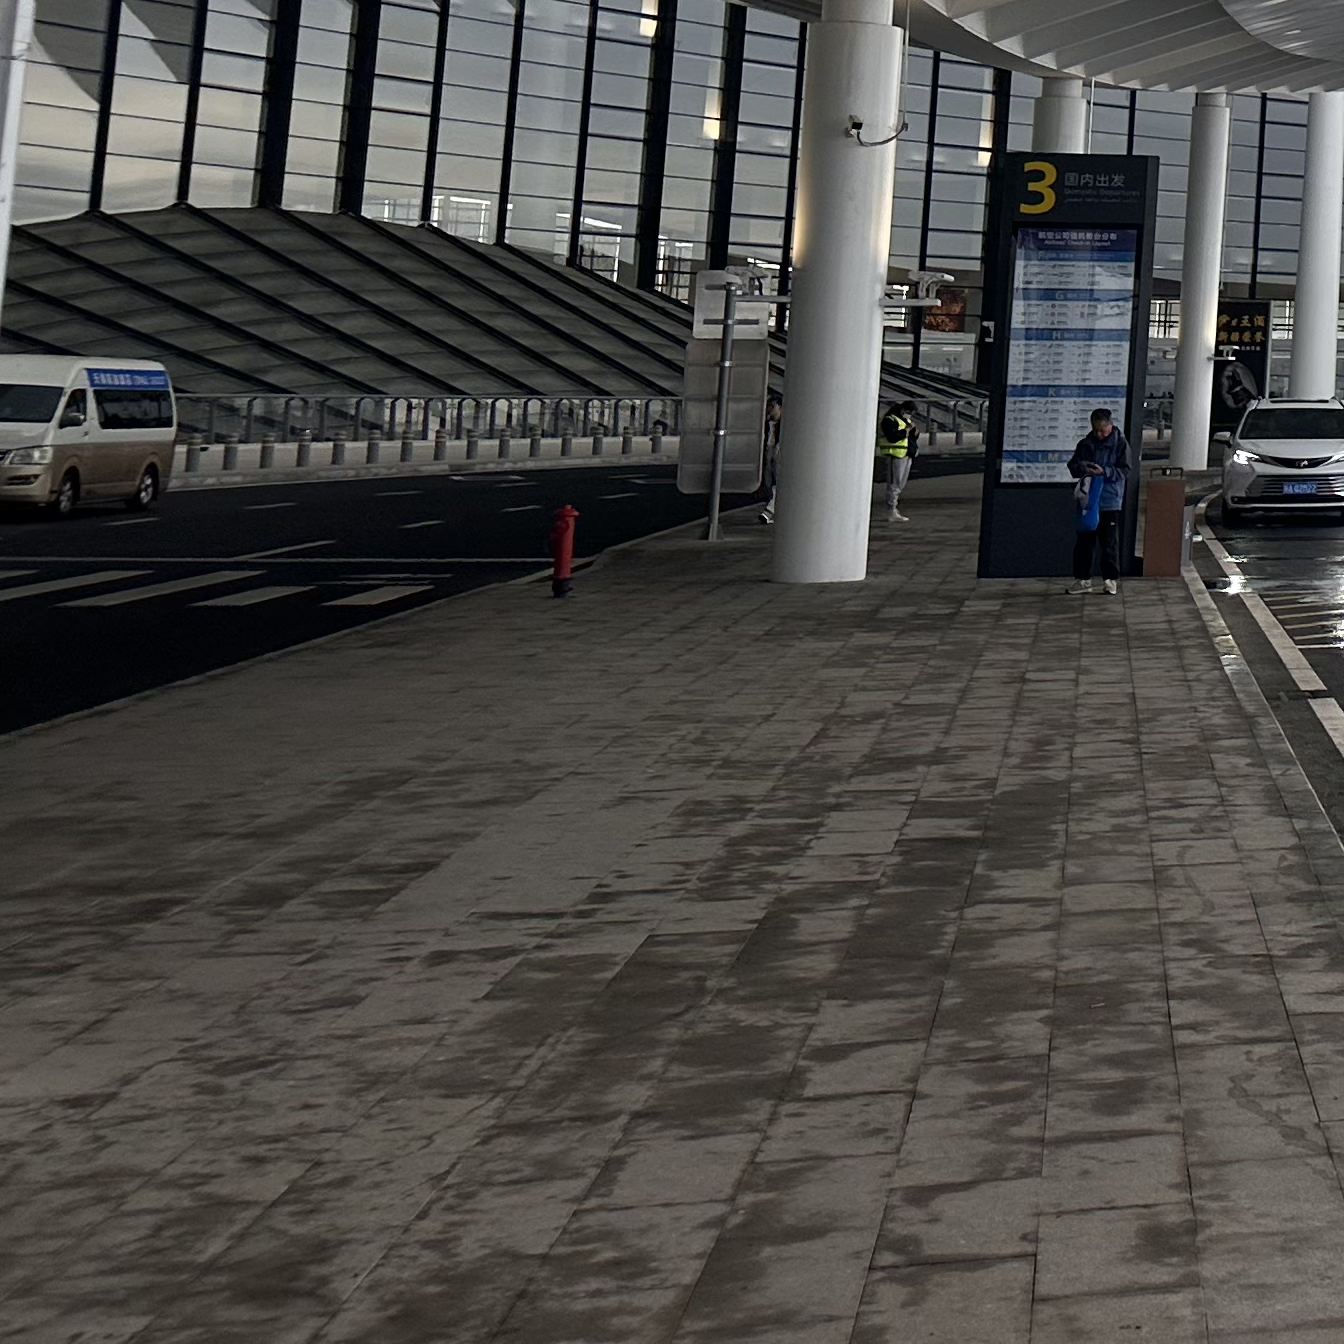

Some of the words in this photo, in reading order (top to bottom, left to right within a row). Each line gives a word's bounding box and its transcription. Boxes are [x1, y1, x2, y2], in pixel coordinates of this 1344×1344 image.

[1020, 161, 1057, 214] 3
[1064, 172, 1125, 187] 国内出发
